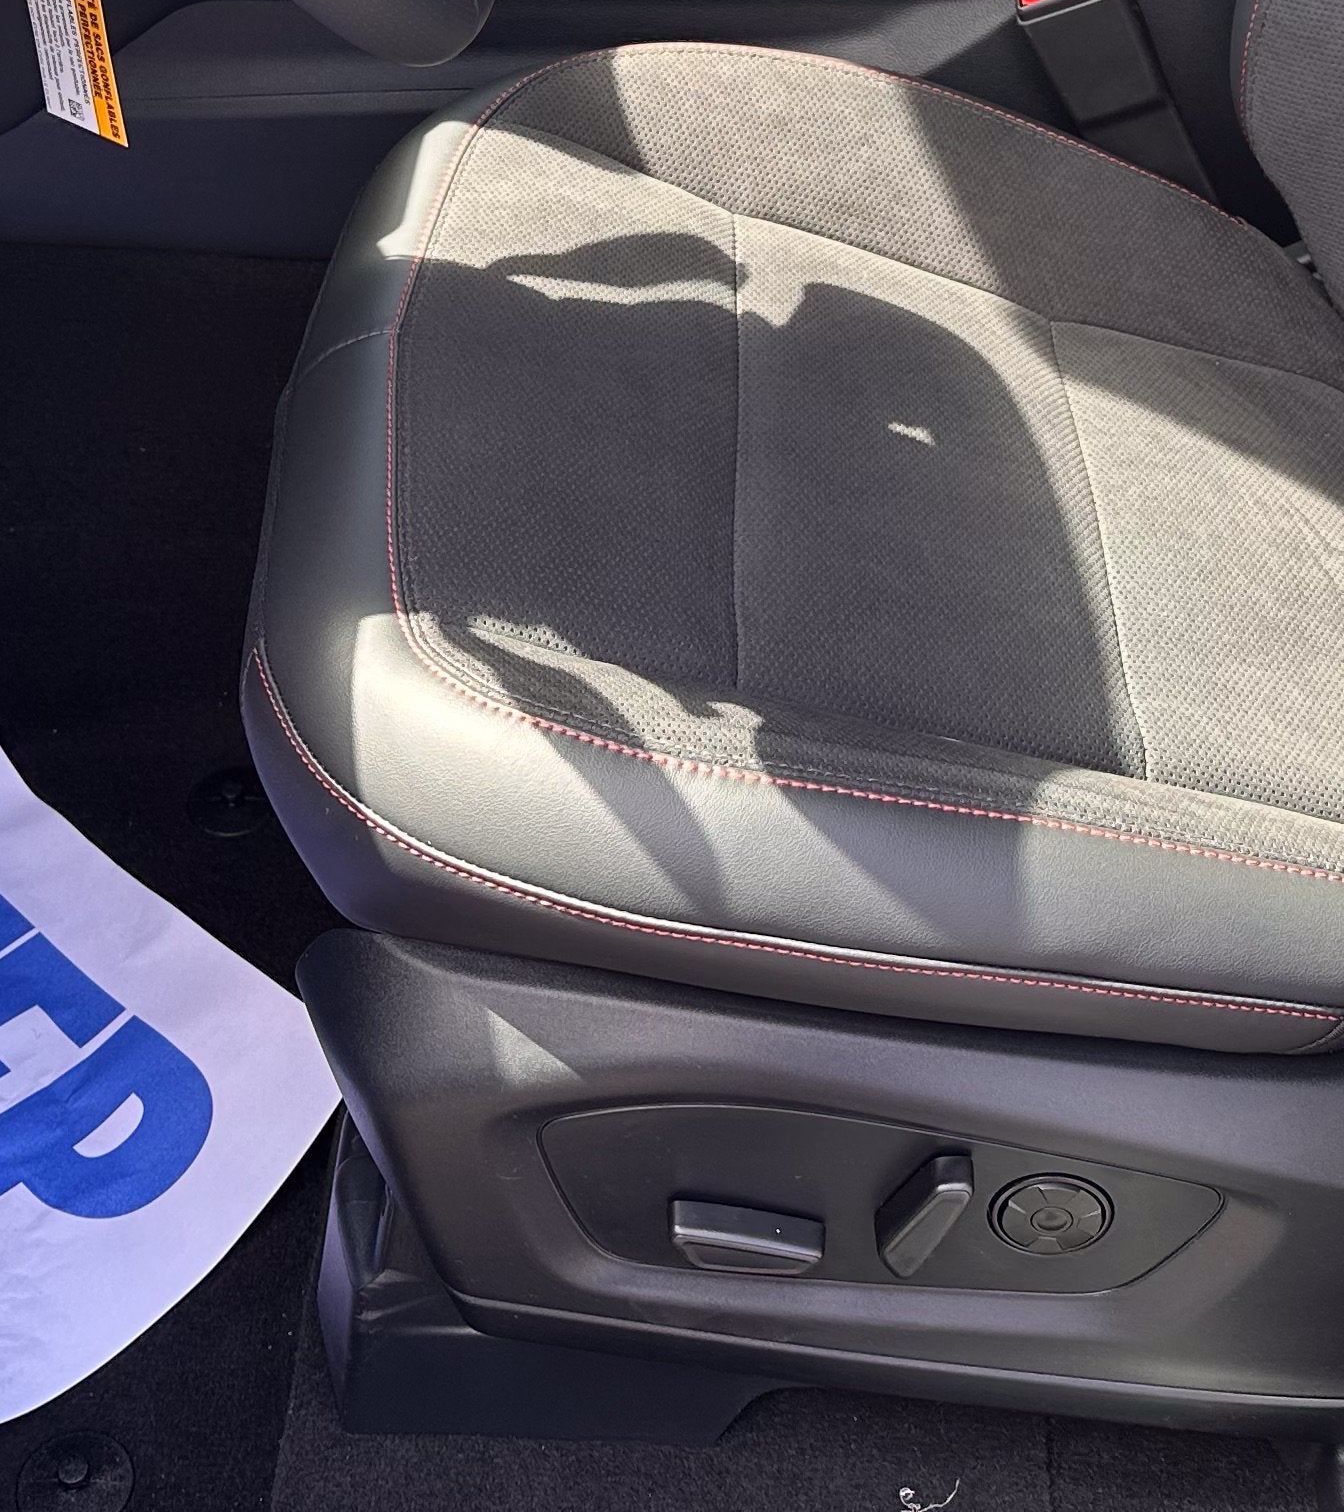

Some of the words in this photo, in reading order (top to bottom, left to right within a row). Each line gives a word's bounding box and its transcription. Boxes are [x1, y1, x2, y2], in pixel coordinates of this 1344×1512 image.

[89, 12, 99, 30] DE
[93, 33, 105, 63] SACS
[100, 65, 121, 139] GONFLABLES
